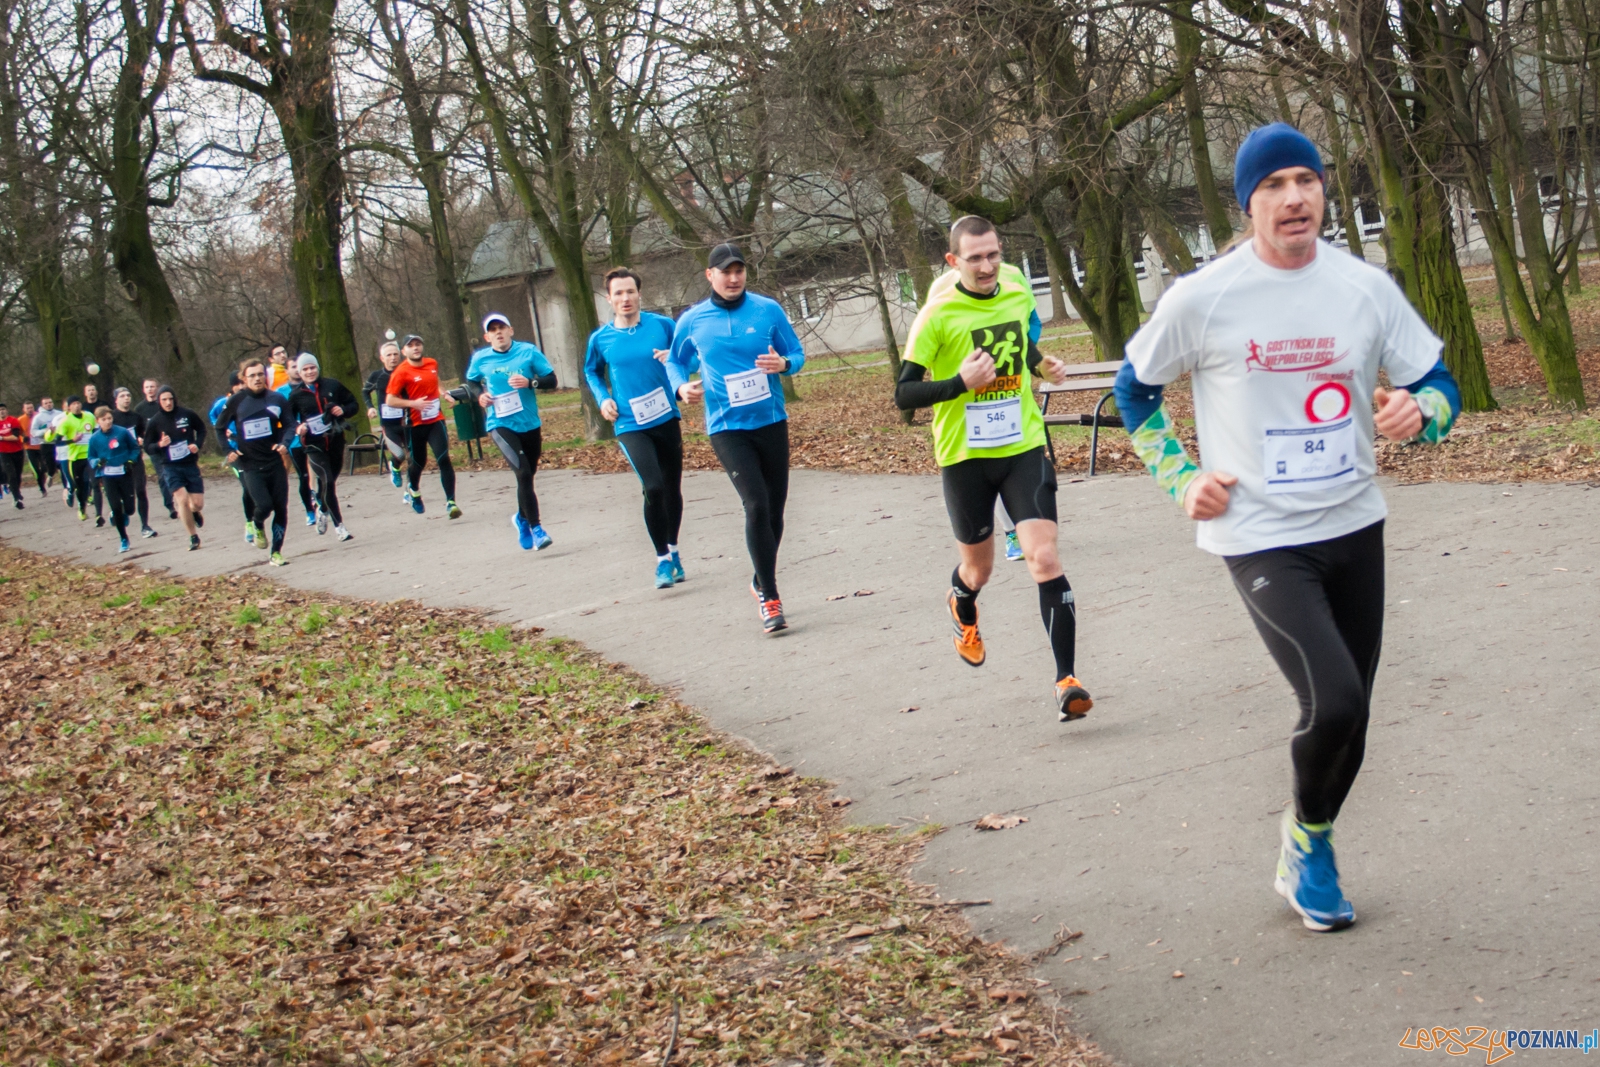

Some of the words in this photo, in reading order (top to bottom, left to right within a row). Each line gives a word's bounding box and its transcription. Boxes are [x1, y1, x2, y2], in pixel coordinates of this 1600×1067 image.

[1266, 336, 1316, 352] GOSTYŃSKI
[1316, 337, 1336, 349] BIEG
[1265, 349, 1335, 366] NIEPODLEGŁOŚCI
[741, 379, 757, 389] 121
[644, 398, 656, 409] 577
[986, 411, 1006, 423] 546
[1304, 439, 1325, 454] 84
